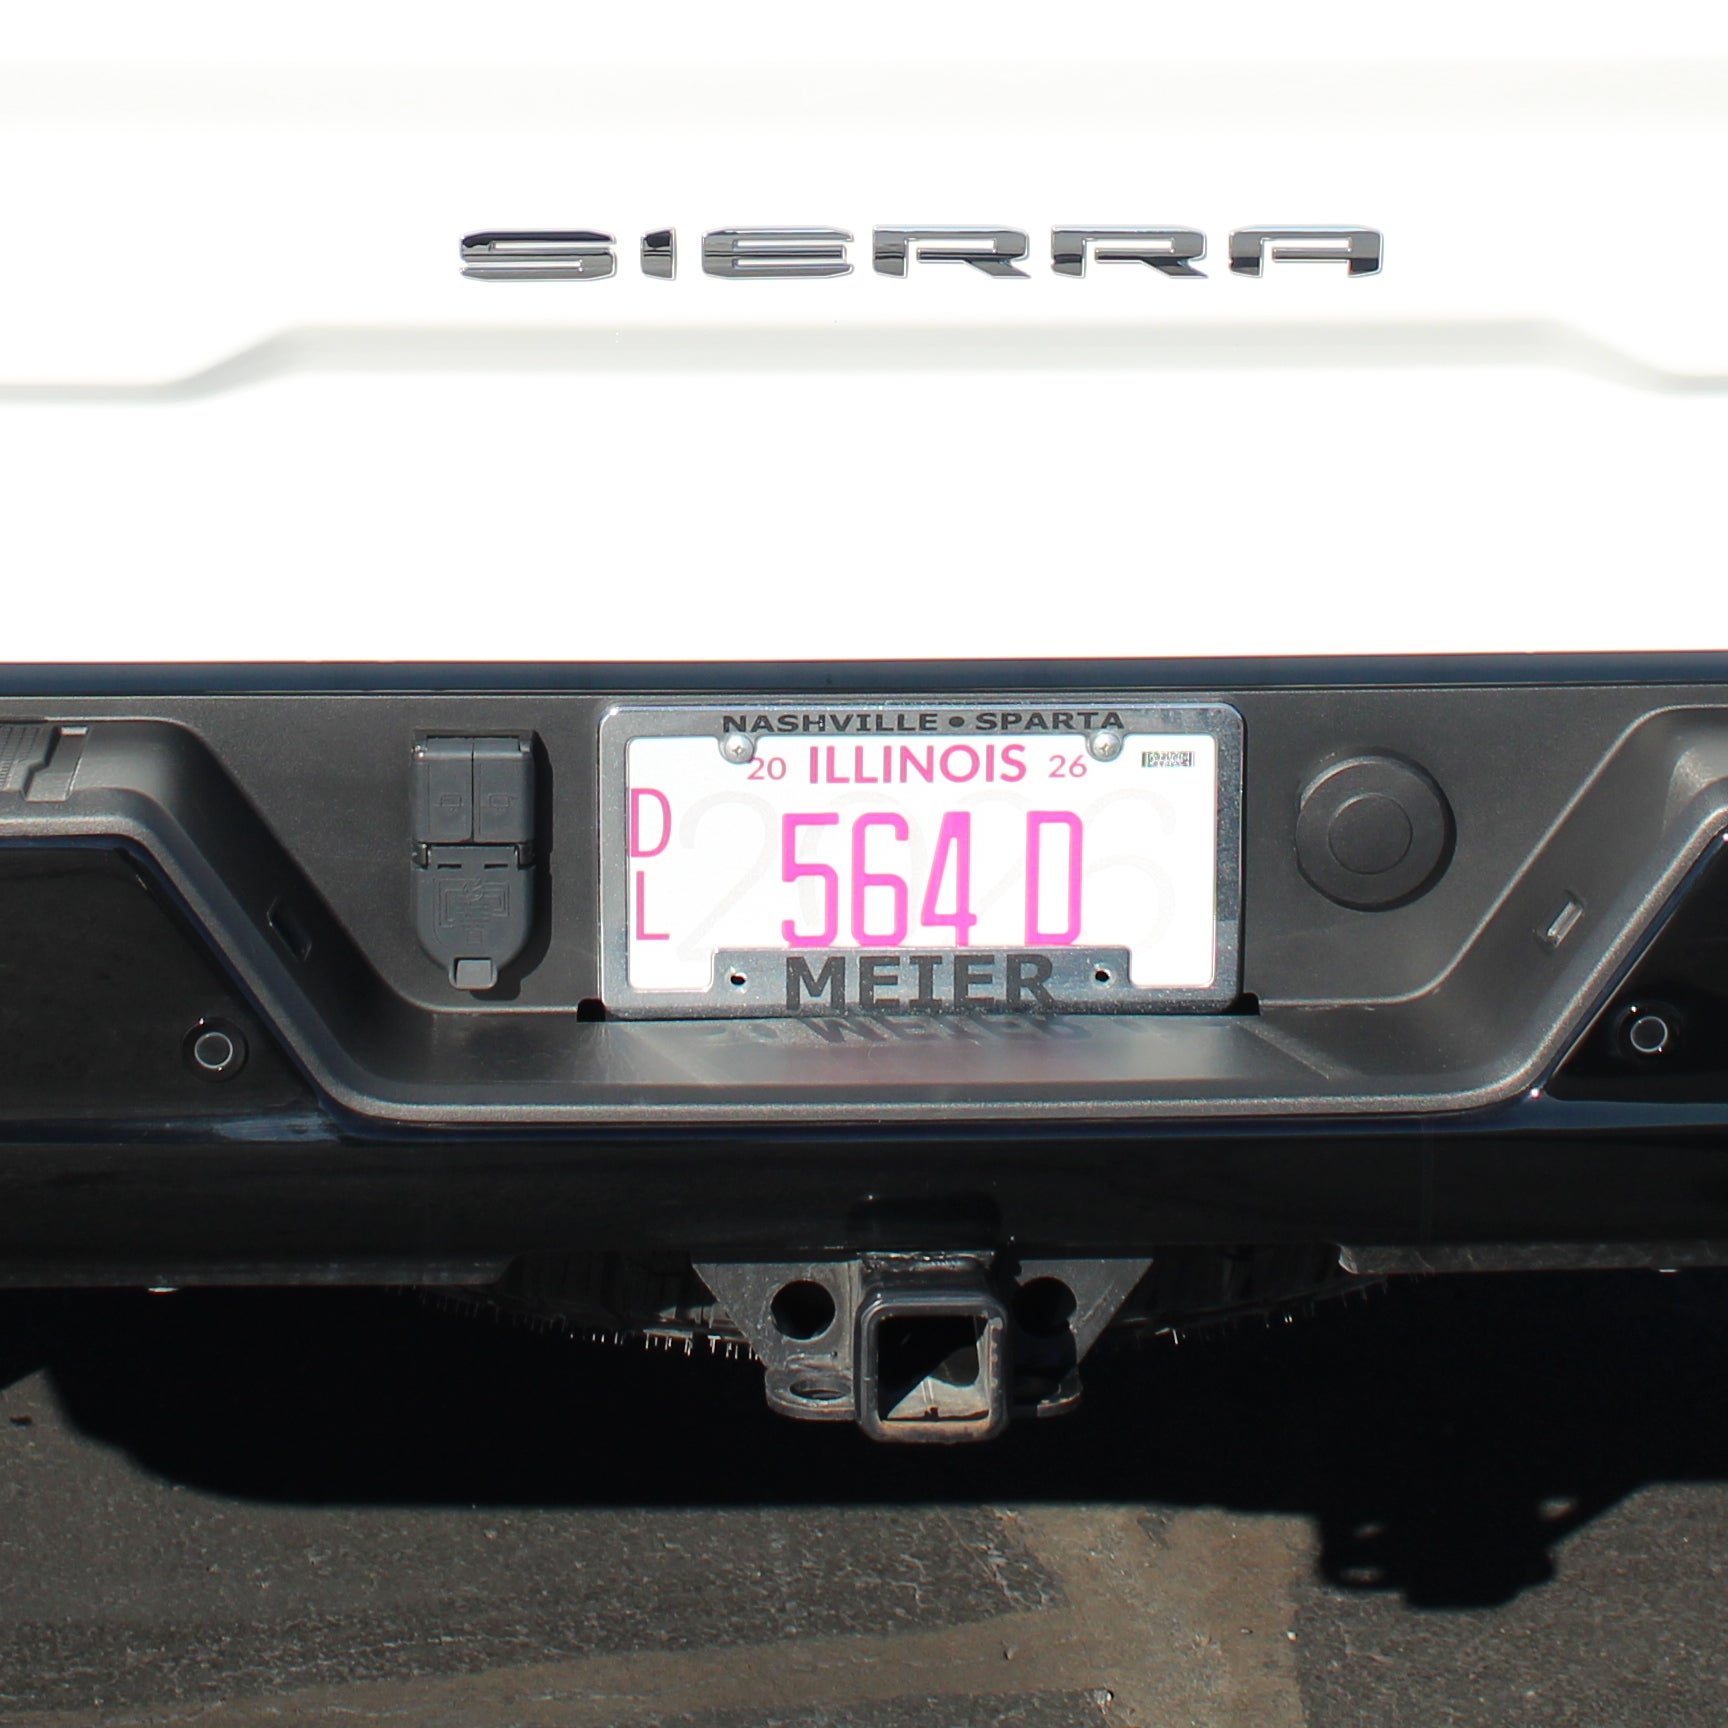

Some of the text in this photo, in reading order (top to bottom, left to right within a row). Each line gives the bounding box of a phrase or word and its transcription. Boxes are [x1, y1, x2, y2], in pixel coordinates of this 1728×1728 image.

[460, 226, 1384, 281] SIERRA
[721, 709, 1125, 734] NASHVILLE SPARTA
[746, 743, 1088, 785] 20 ILLINOIS 26
[781, 810, 1084, 947] 564 D
[784, 953, 1056, 1011] MEIER
